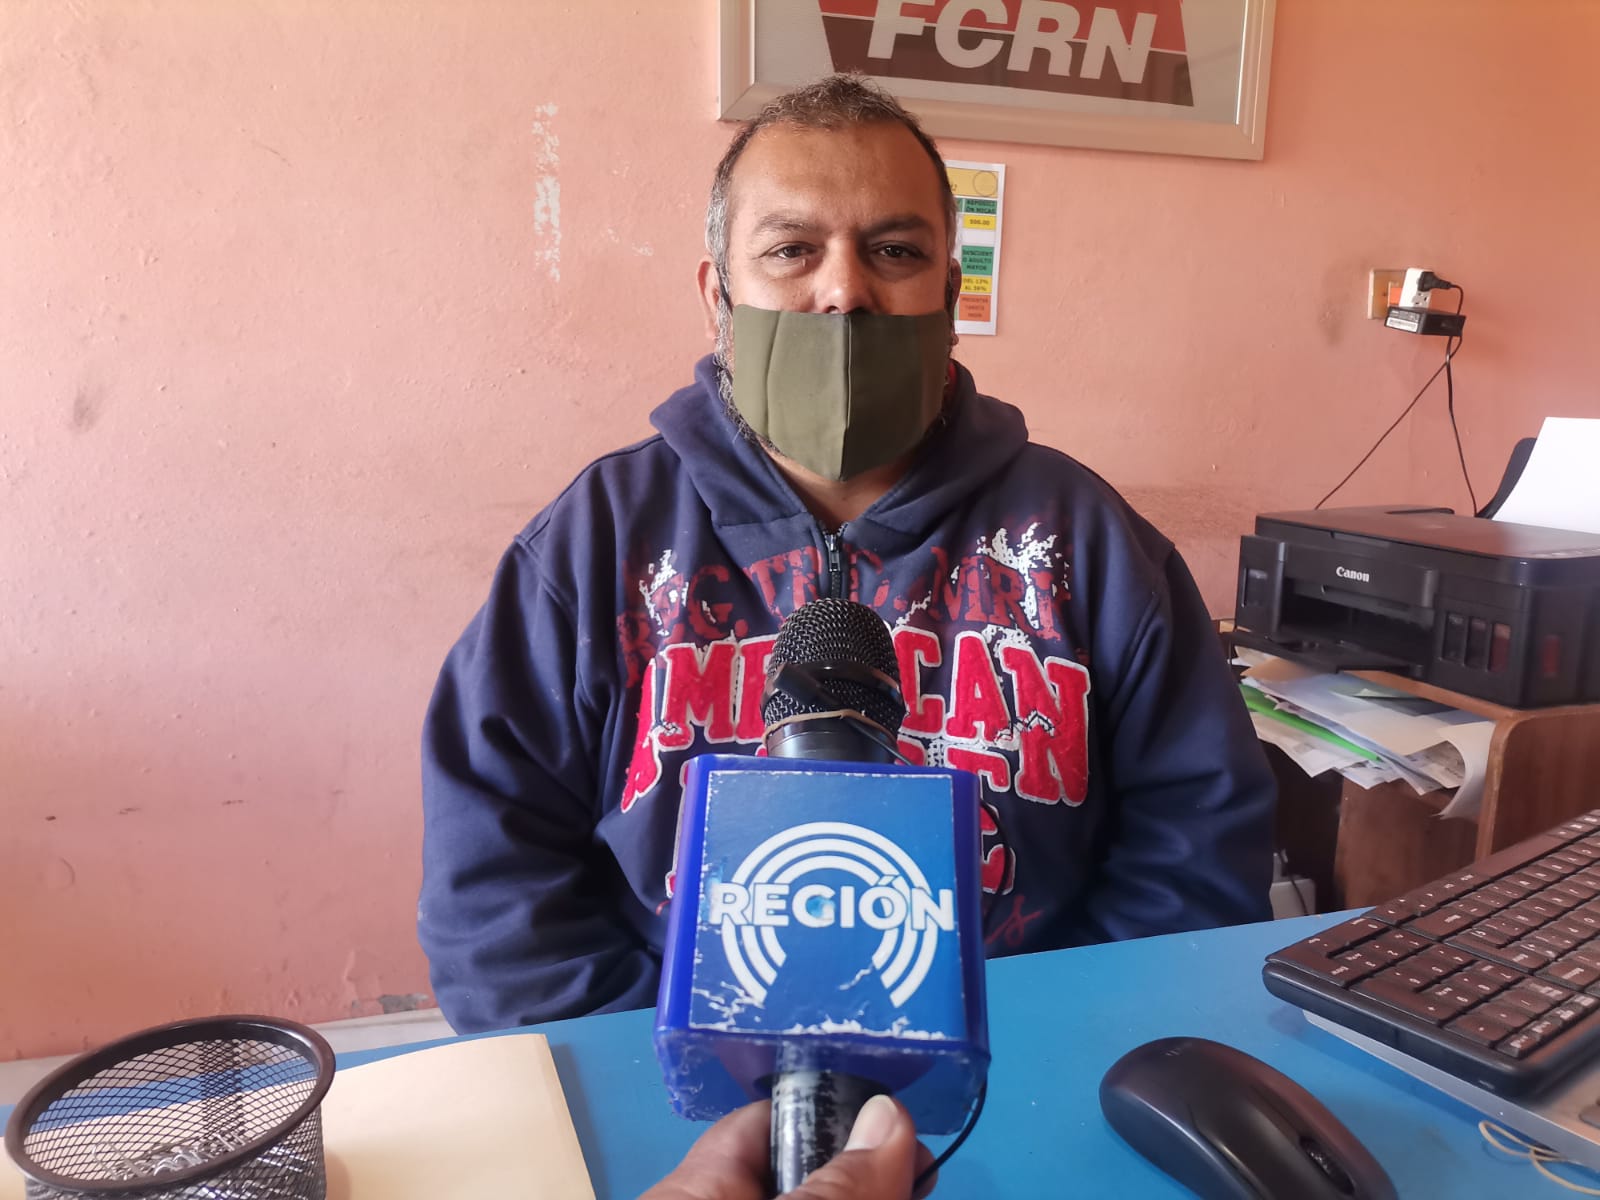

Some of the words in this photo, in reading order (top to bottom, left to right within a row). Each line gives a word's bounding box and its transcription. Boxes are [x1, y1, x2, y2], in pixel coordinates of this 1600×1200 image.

[867, 0, 1158, 84] FCRN
[1335, 566, 1370, 583] Canon
[621, 624, 1091, 813] AMCAN
[709, 875, 955, 931] REGIÓN
